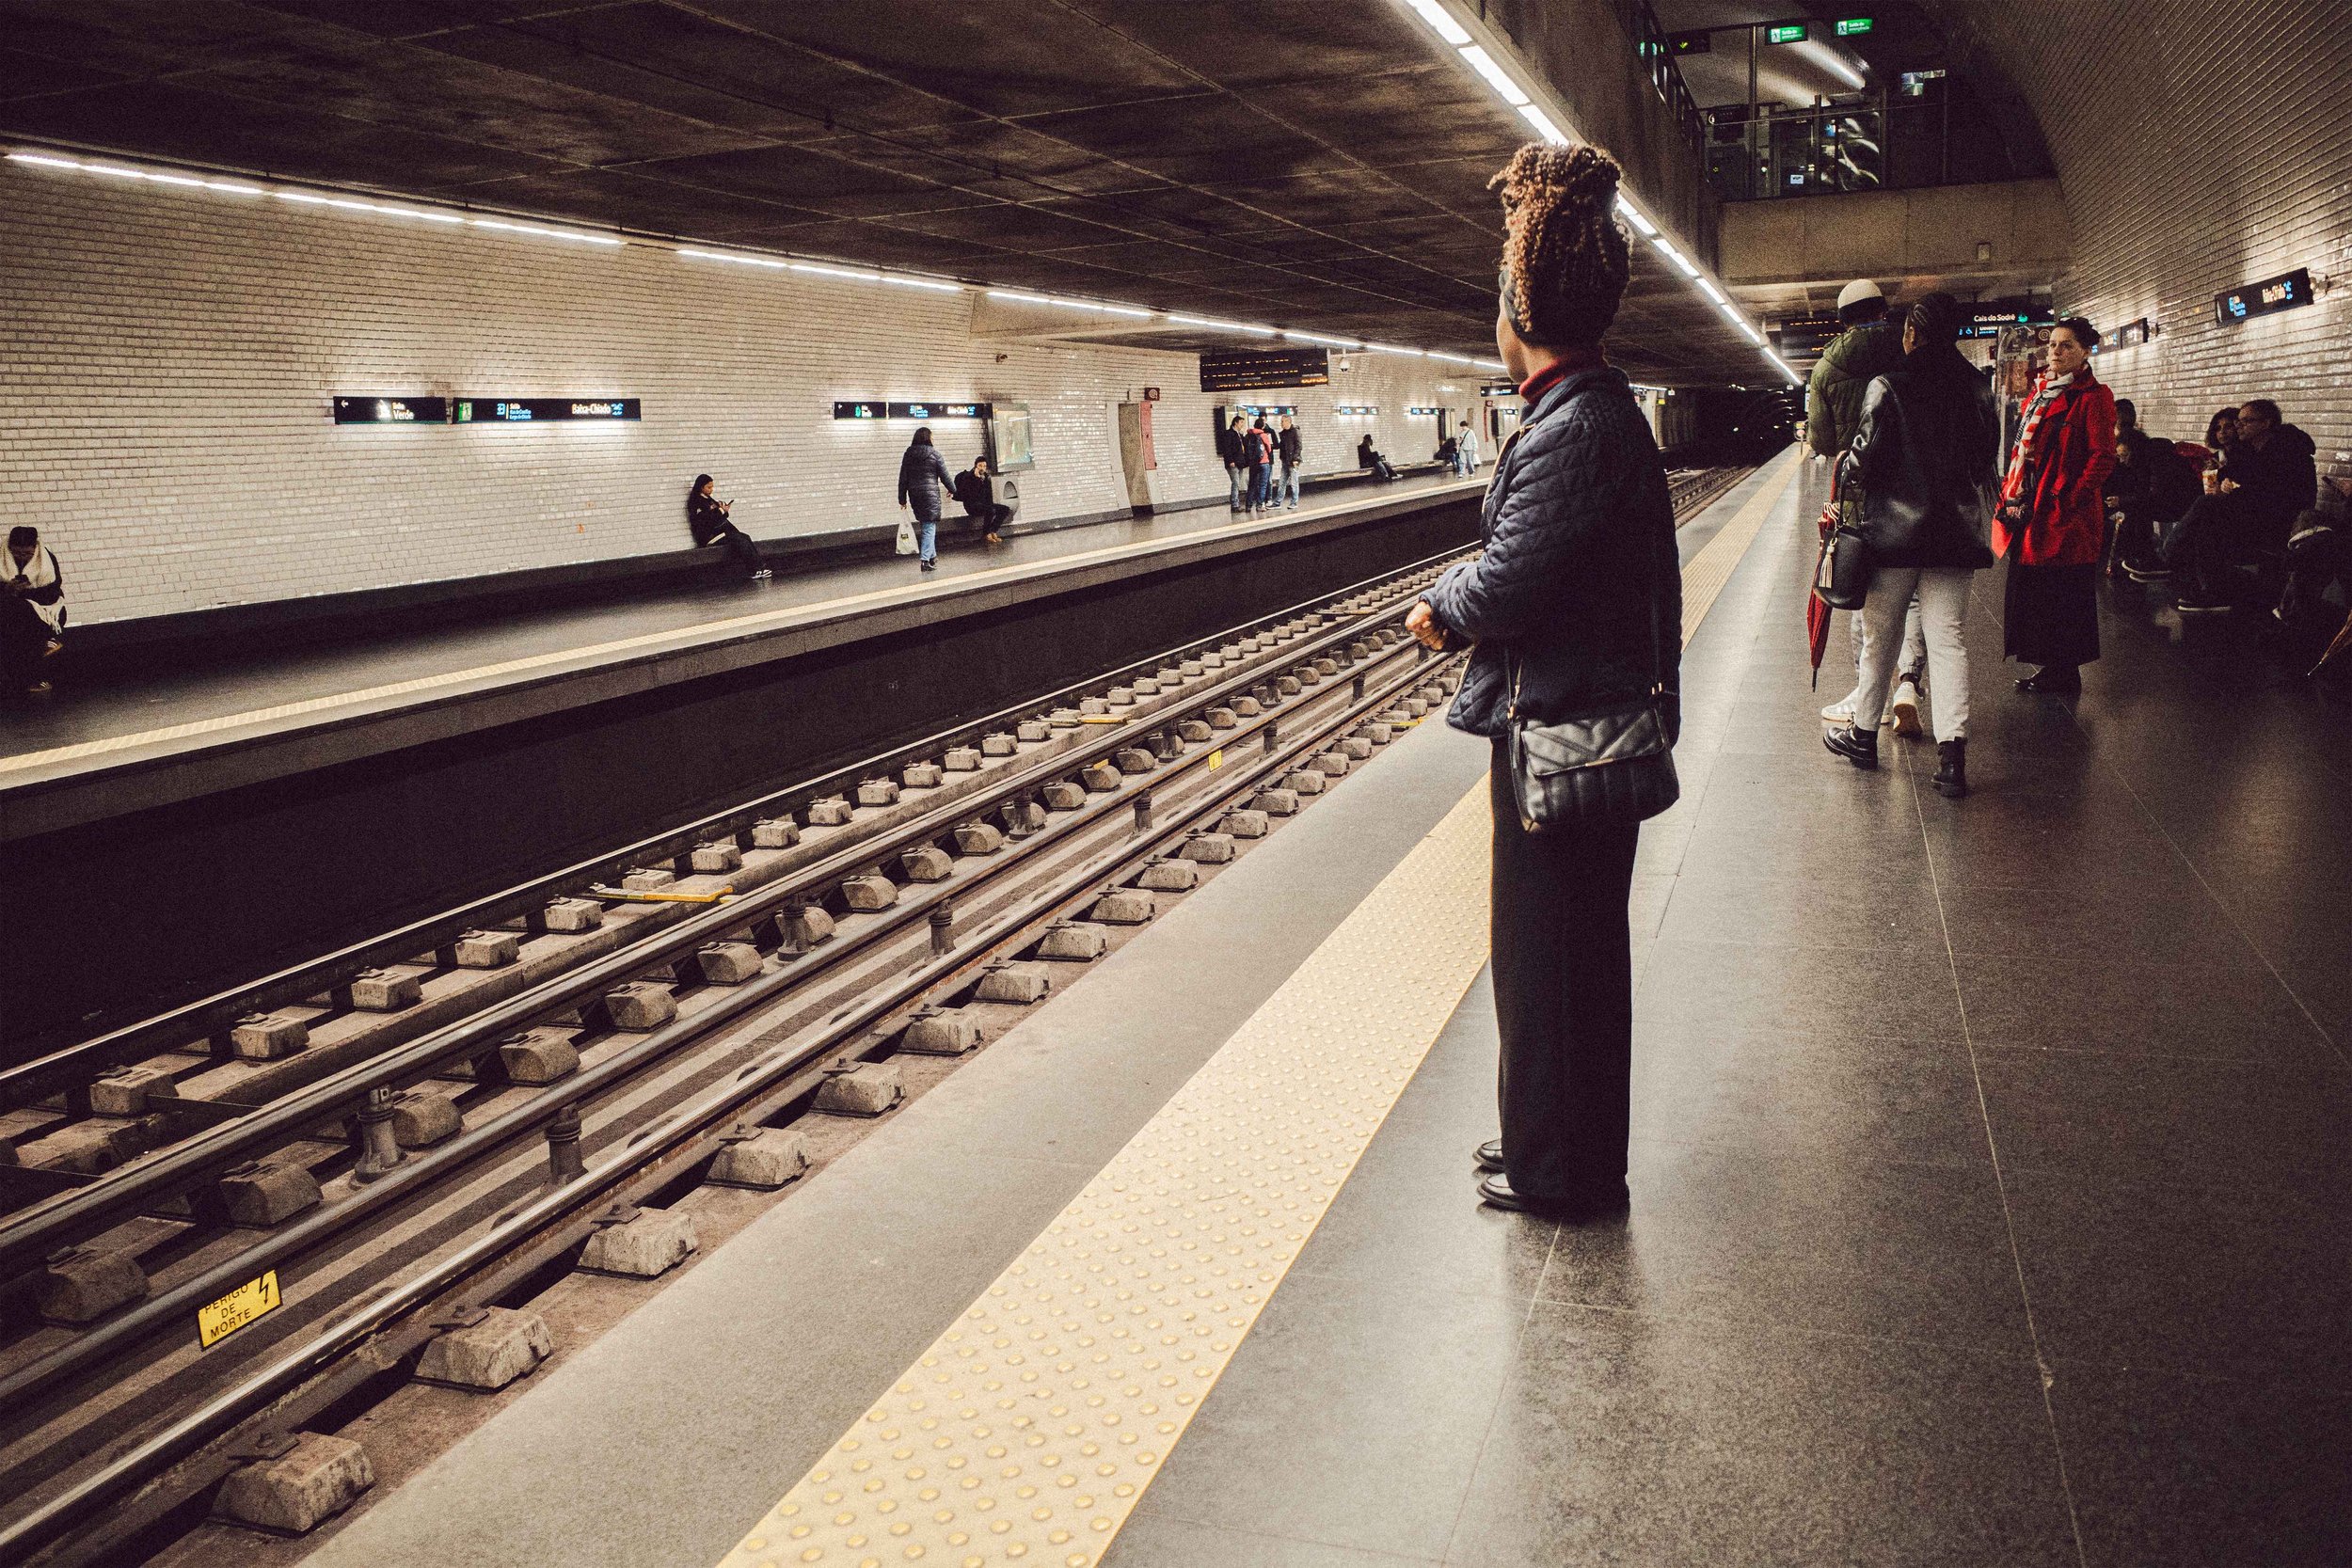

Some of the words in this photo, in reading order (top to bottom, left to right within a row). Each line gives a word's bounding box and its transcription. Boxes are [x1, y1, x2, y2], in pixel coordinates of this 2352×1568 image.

[393, 409, 415, 420] Verde
[571, 404, 612, 415] Baixa-Chiado
[221, 1303, 236, 1318] DE
[210, 1307, 251, 1338] MORTE
